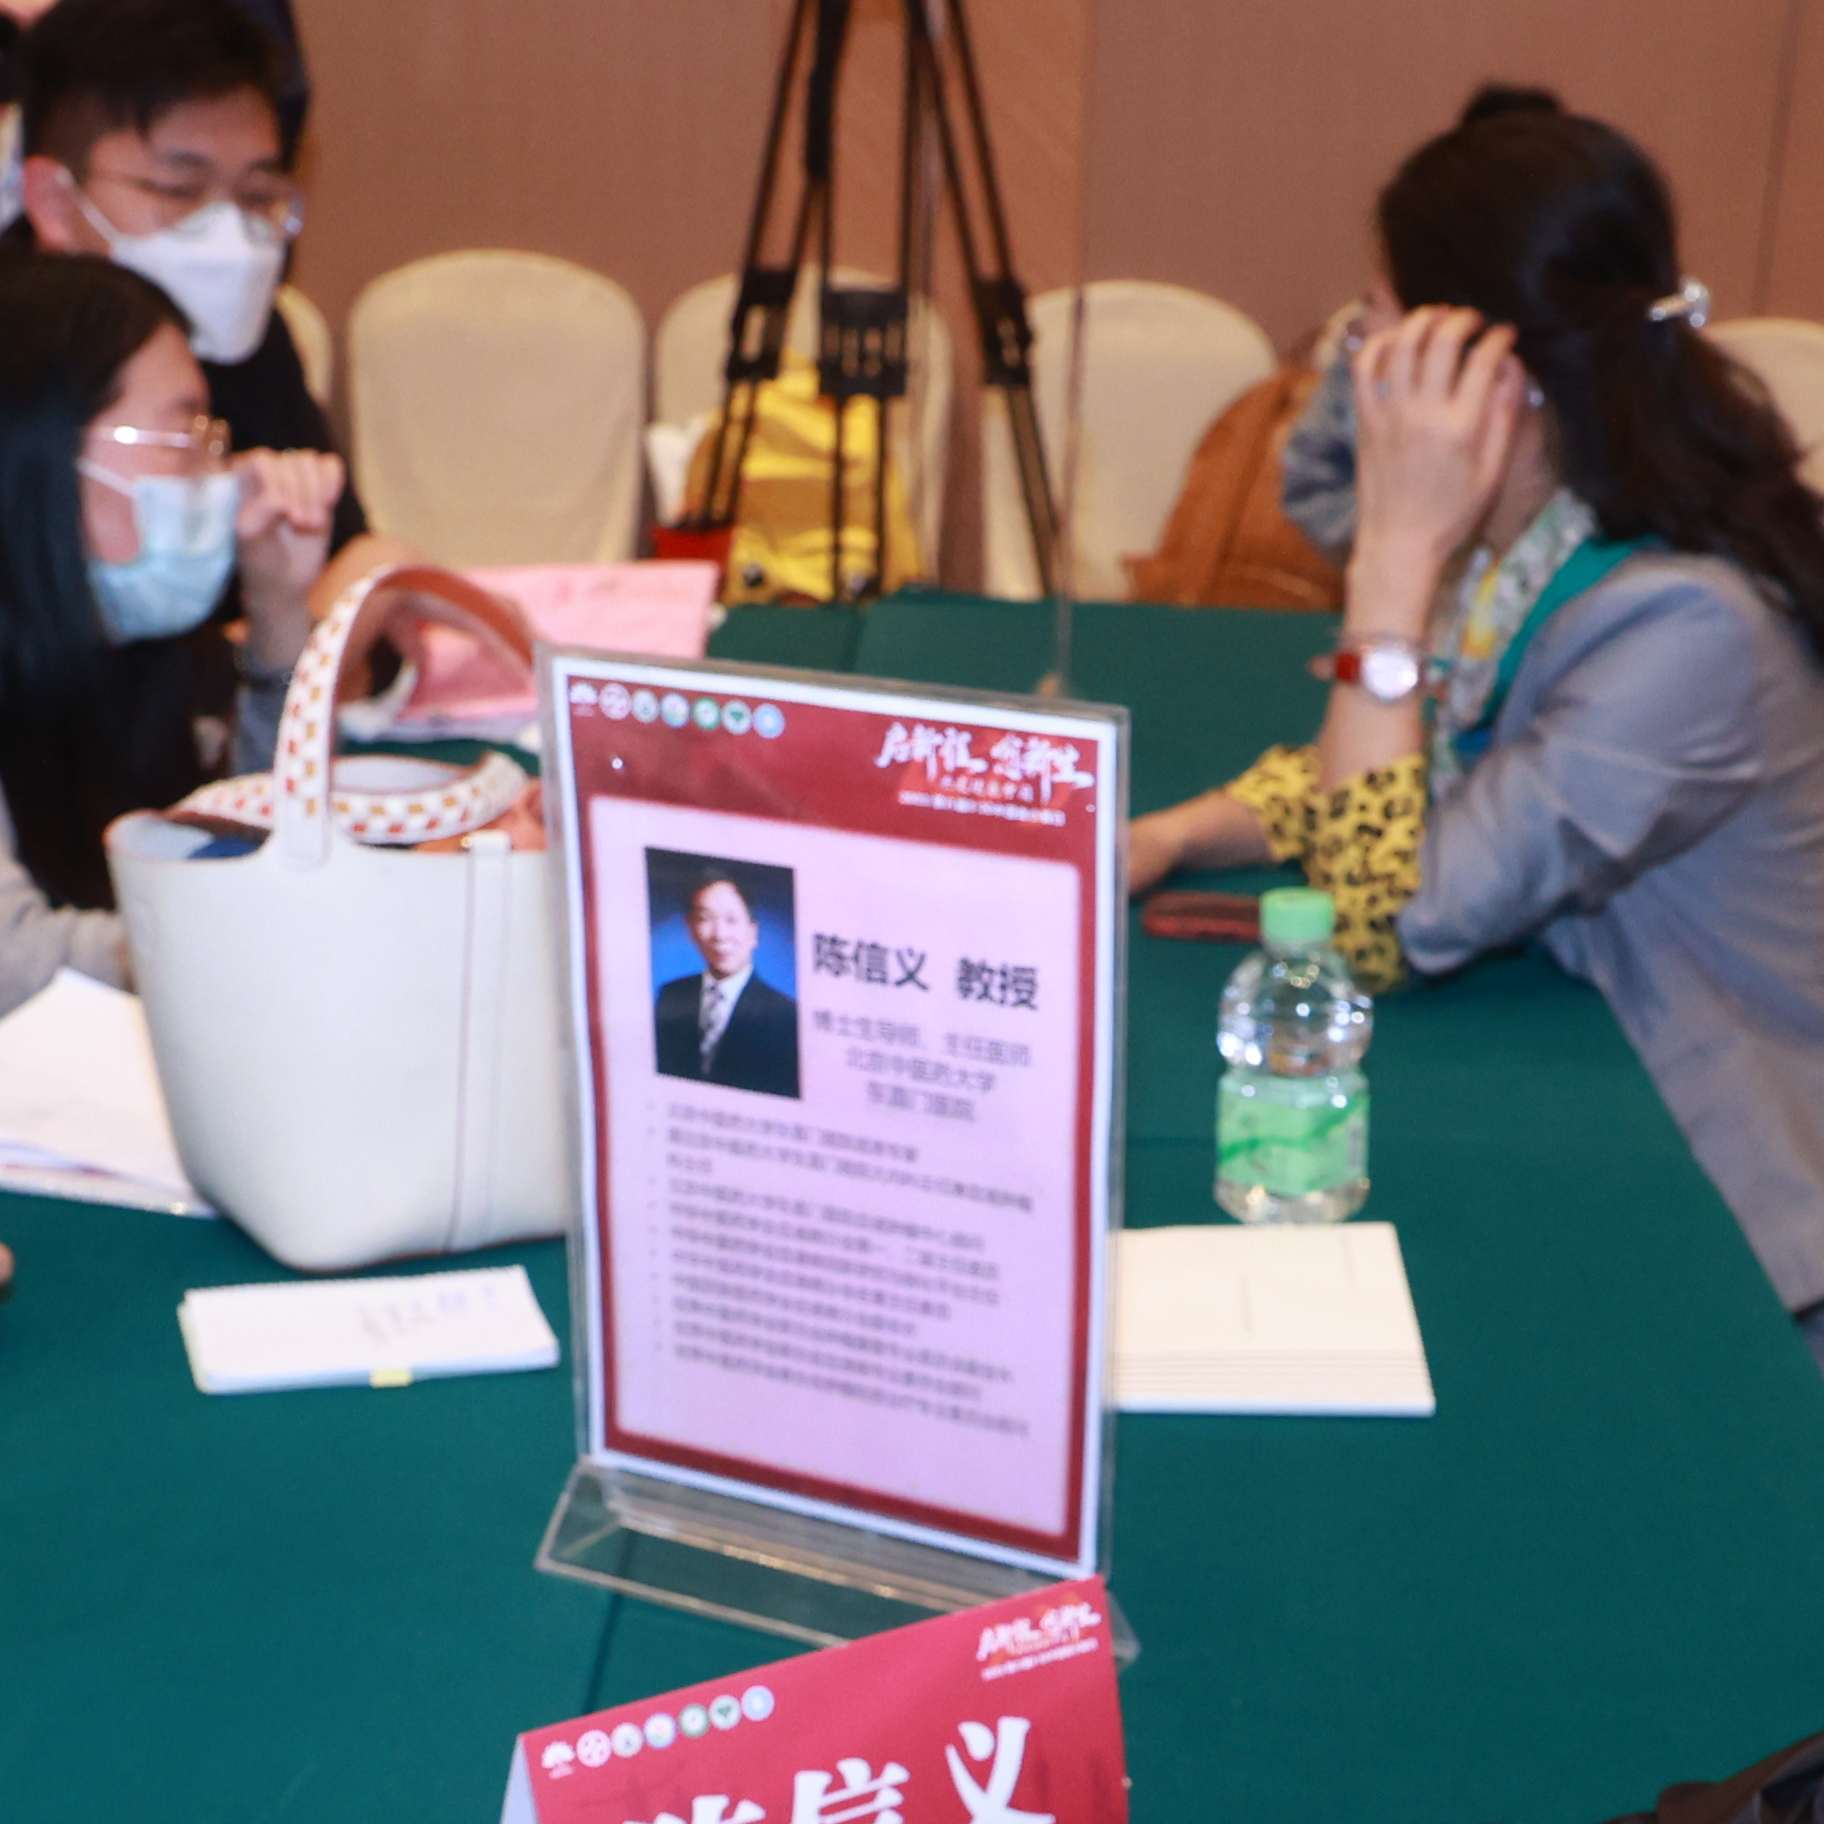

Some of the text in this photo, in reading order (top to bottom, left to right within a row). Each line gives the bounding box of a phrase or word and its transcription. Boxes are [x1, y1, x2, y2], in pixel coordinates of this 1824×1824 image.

[813, 932, 1038, 1010] 陈信义 教授
